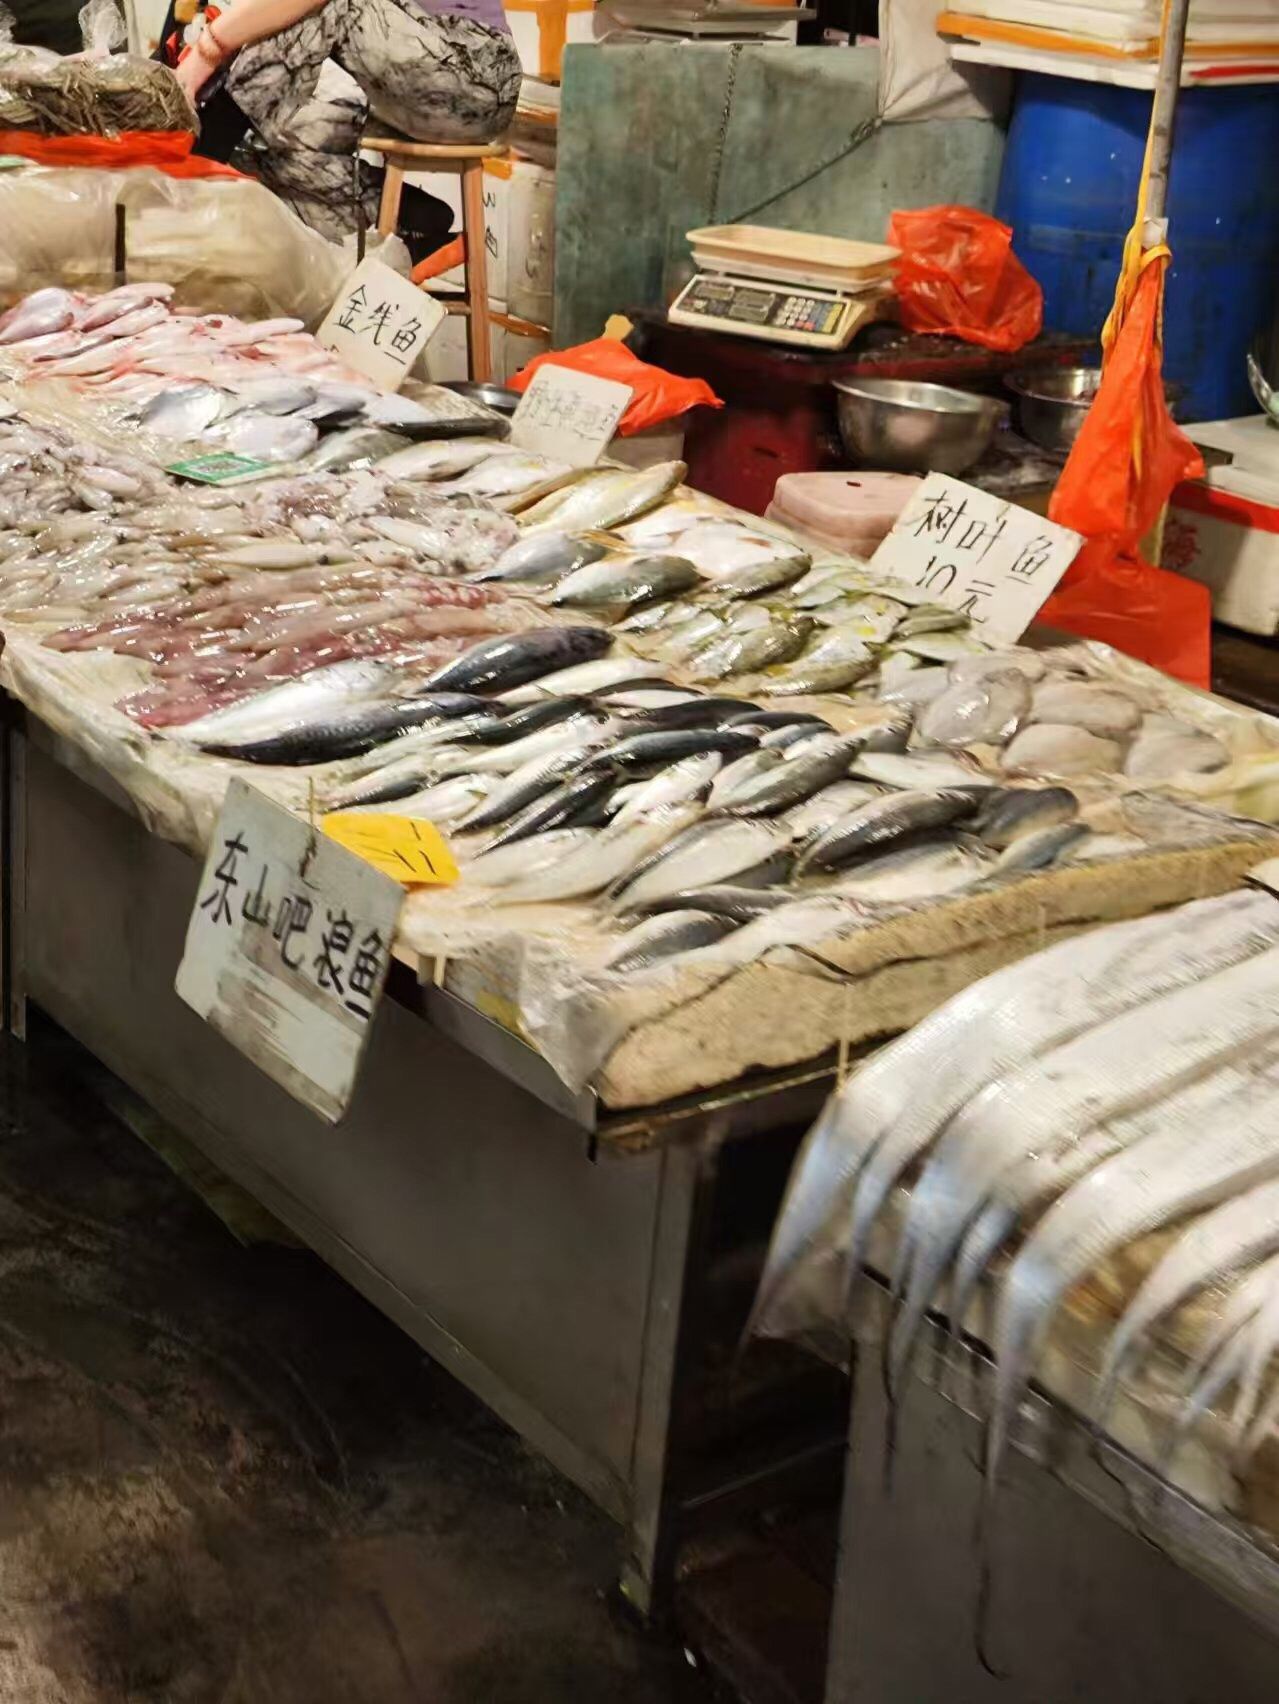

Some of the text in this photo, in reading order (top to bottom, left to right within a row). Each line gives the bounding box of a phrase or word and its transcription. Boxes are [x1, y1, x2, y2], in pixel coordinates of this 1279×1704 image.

[333, 284, 421, 365] 金线鱼
[913, 490, 1053, 585] 树叶鱼
